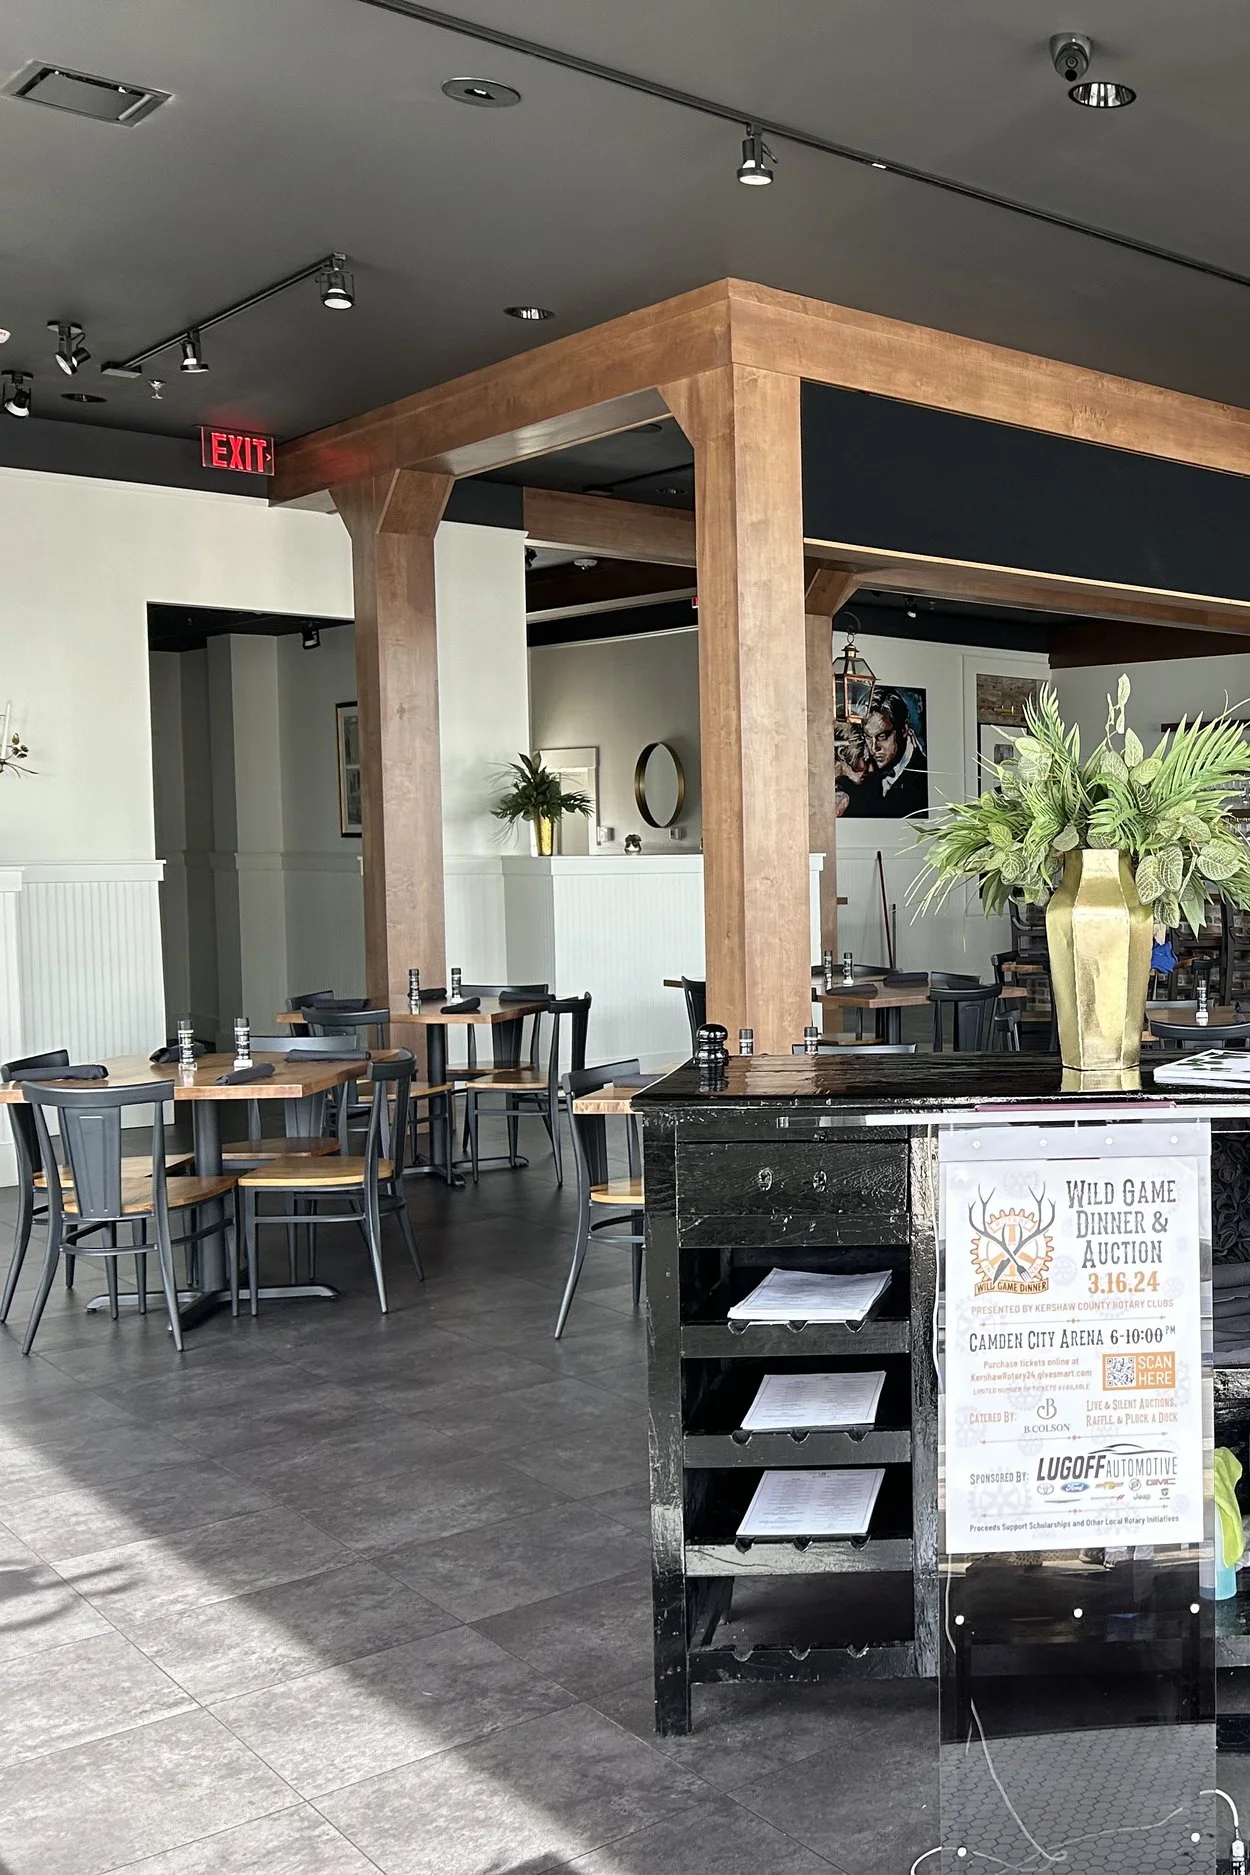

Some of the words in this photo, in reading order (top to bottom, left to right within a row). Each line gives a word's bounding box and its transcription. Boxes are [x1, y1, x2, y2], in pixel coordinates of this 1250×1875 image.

[211, 432, 267, 473] EXIT
[1066, 1180, 1114, 1208] WILD
[1122, 1179, 1176, 1207] GAME
[1076, 1210, 1145, 1238] DINNER
[1151, 1211, 1169, 1233] &
[1082, 1240, 1163, 1269] AUCTION
[997, 1282, 1018, 1291] GAME
[1019, 1282, 1047, 1292] DINNER
[1087, 1271, 1160, 1294] 3.16.24
[971, 1304, 1021, 1315] PRESENTED
[1022, 1304, 1033, 1314] BY
[1035, 1302, 1076, 1313] KERSHAW
[1077, 1301, 1111, 1311] COUNTY
[1112, 1300, 1146, 1310] ROTARY
[1147, 1299, 1174, 1309] CLUBS
[969, 1332, 1023, 1352] CAMDEN
[1027, 1330, 1055, 1350] CITY
[1059, 1329, 1104, 1349] ARENA
[1110, 1327, 1163, 1346] 6-10:00
[1165, 1325, 1176, 1335] PM
[983, 1360, 1018, 1369] Purchase
[1020, 1359, 1046, 1368] tickets
[1047, 1358, 1069, 1366] online
[1138, 1355, 1172, 1370] SCAN
[1138, 1370, 1173, 1386] HERE
[973, 1387, 996, 1395] LIMITED
[997, 1386, 1022, 1394] NUMBER
[1032, 1384, 1056, 1392] TICKETS
[1057, 1383, 1091, 1391] AVAILABLE
[1086, 1399, 1102, 1412] LIVE
[1104, 1400, 1111, 1410] &
[1112, 1398, 1137, 1411] SILENT
[969, 1412, 1001, 1424] CATERED
[1003, 1411, 1017, 1423] BY:
[1116, 1413, 1123, 1425] &
[1125, 1412, 1150, 1424] PLUCK
[1151, 1412, 1157, 1423] A
[1158, 1411, 1178, 1423] DUCK
[1036, 1454, 1106, 1482] LUGOFF
[1105, 1456, 1178, 1478] AUTOMOTIVE
[970, 1472, 1014, 1485] SPONSORED
[1015, 1470, 1029, 1483] BY:
[1146, 1478, 1176, 1486] GMC
[1065, 1483, 1085, 1493] Ford
[969, 1524, 1000, 1532] Proceeds
[1001, 1523, 1028, 1531] Support
[1029, 1520, 1071, 1530] Scholarships
[1072, 1519, 1085, 1527] and
[1086, 1518, 1104, 1527] Other
[1105, 1517, 1123, 1525] Local
[1124, 1516, 1145, 1525] Rotary
[1146, 1515, 1179, 1524] Initiatives
